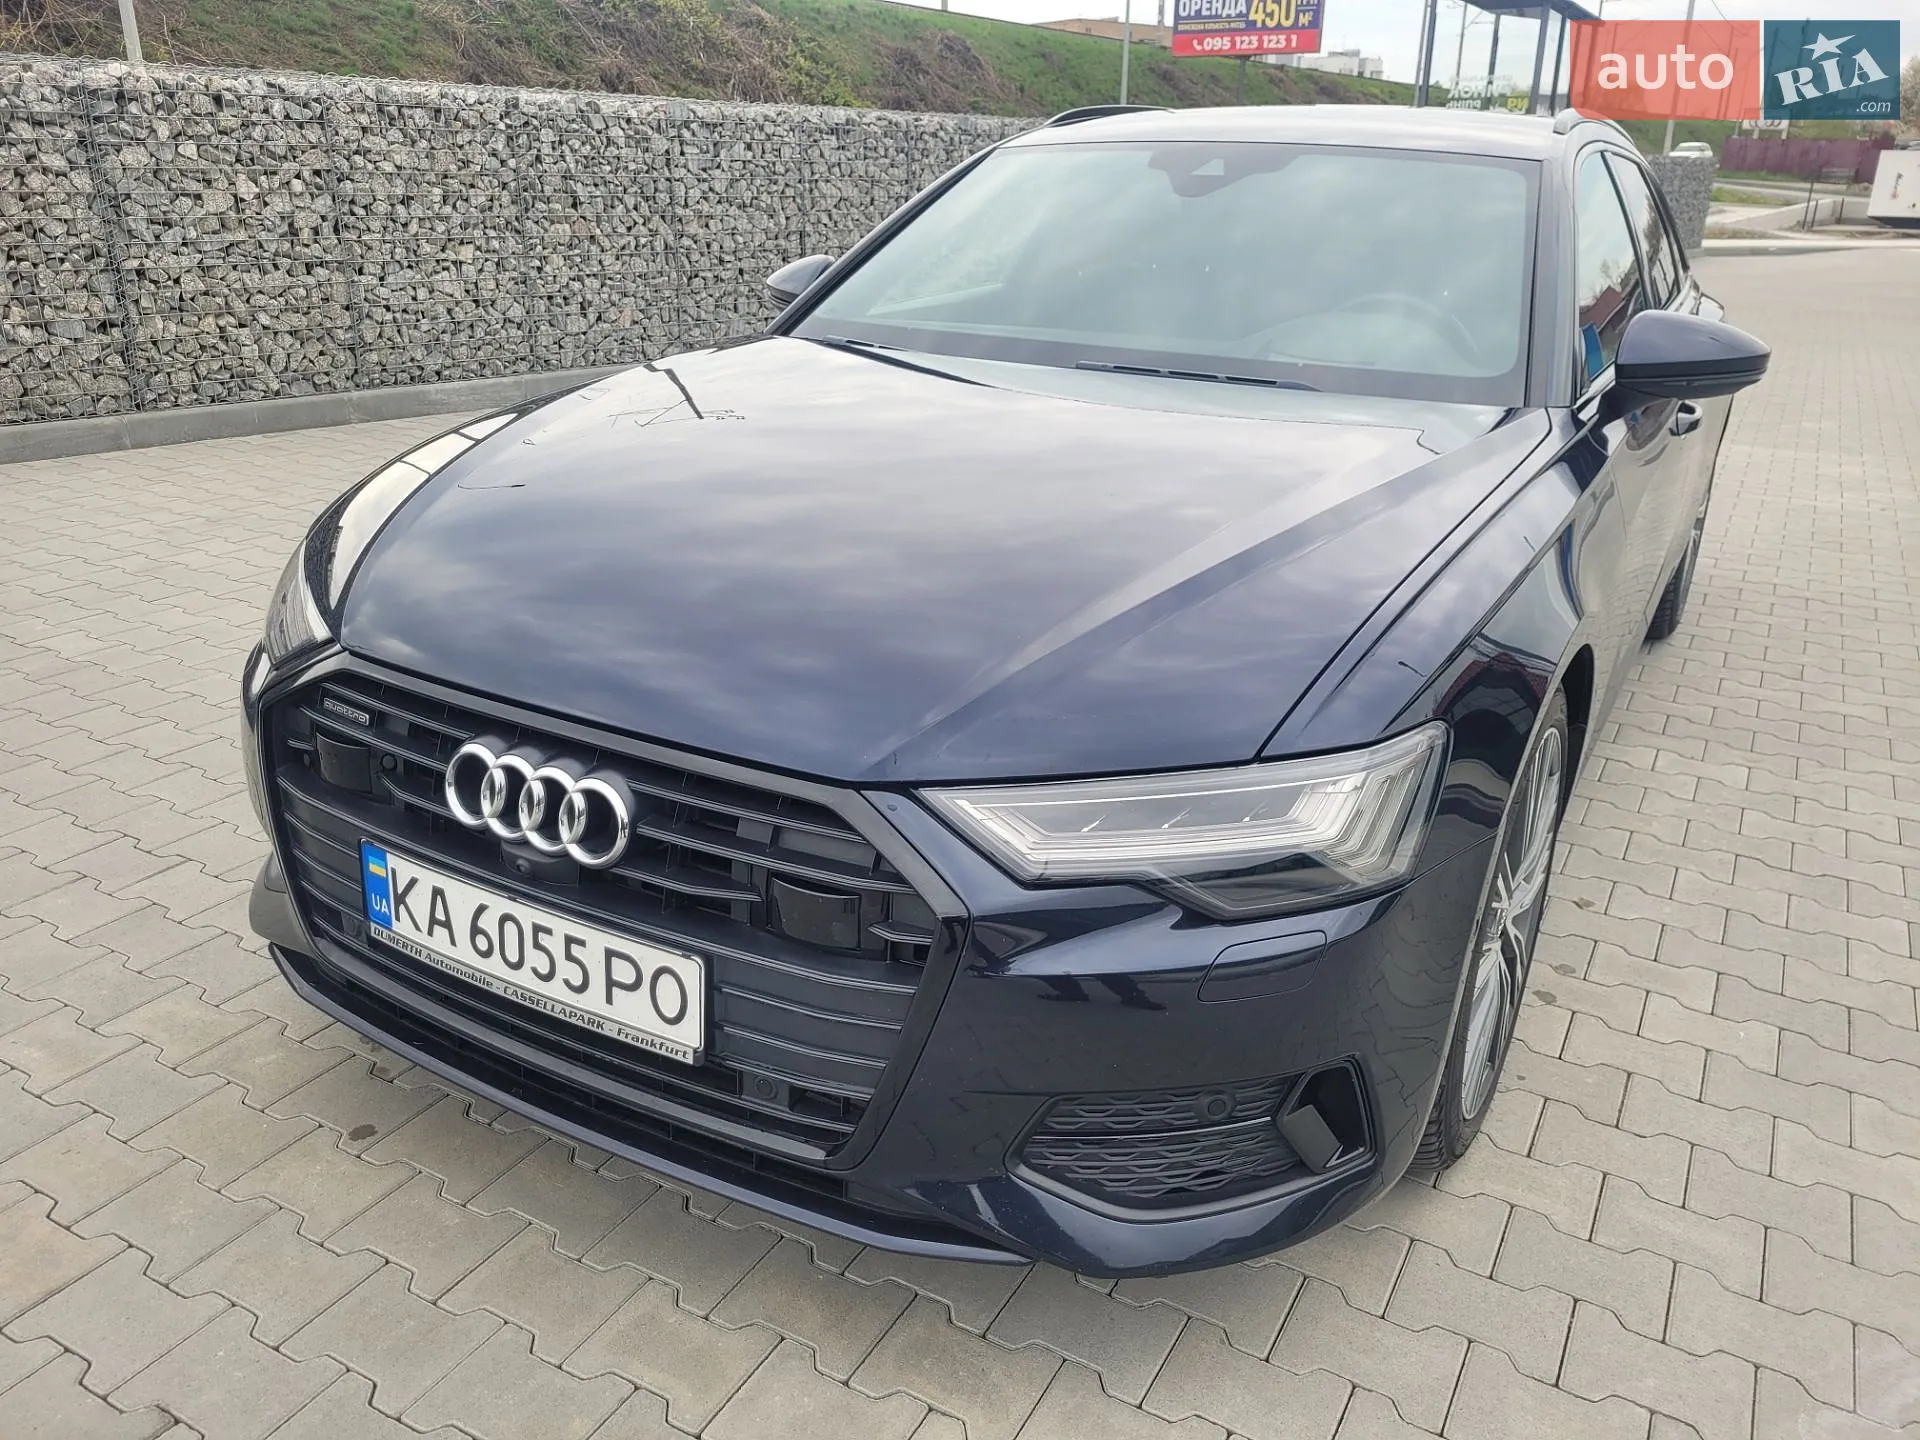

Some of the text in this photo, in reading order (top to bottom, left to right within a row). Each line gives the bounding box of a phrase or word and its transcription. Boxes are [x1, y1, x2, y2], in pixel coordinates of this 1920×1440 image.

[1178, 0, 1296, 28] ОРЕНДА 450
[1203, 34, 1298, 51] 095 123 123 1
[371, 893, 389, 916] UA
[390, 866, 689, 1026] KA 6055 PO
[424, 952, 494, 988] Automobile
[503, 984, 605, 1031] CASSELLAPARK
[616, 1027, 690, 1060] Frankfurt
